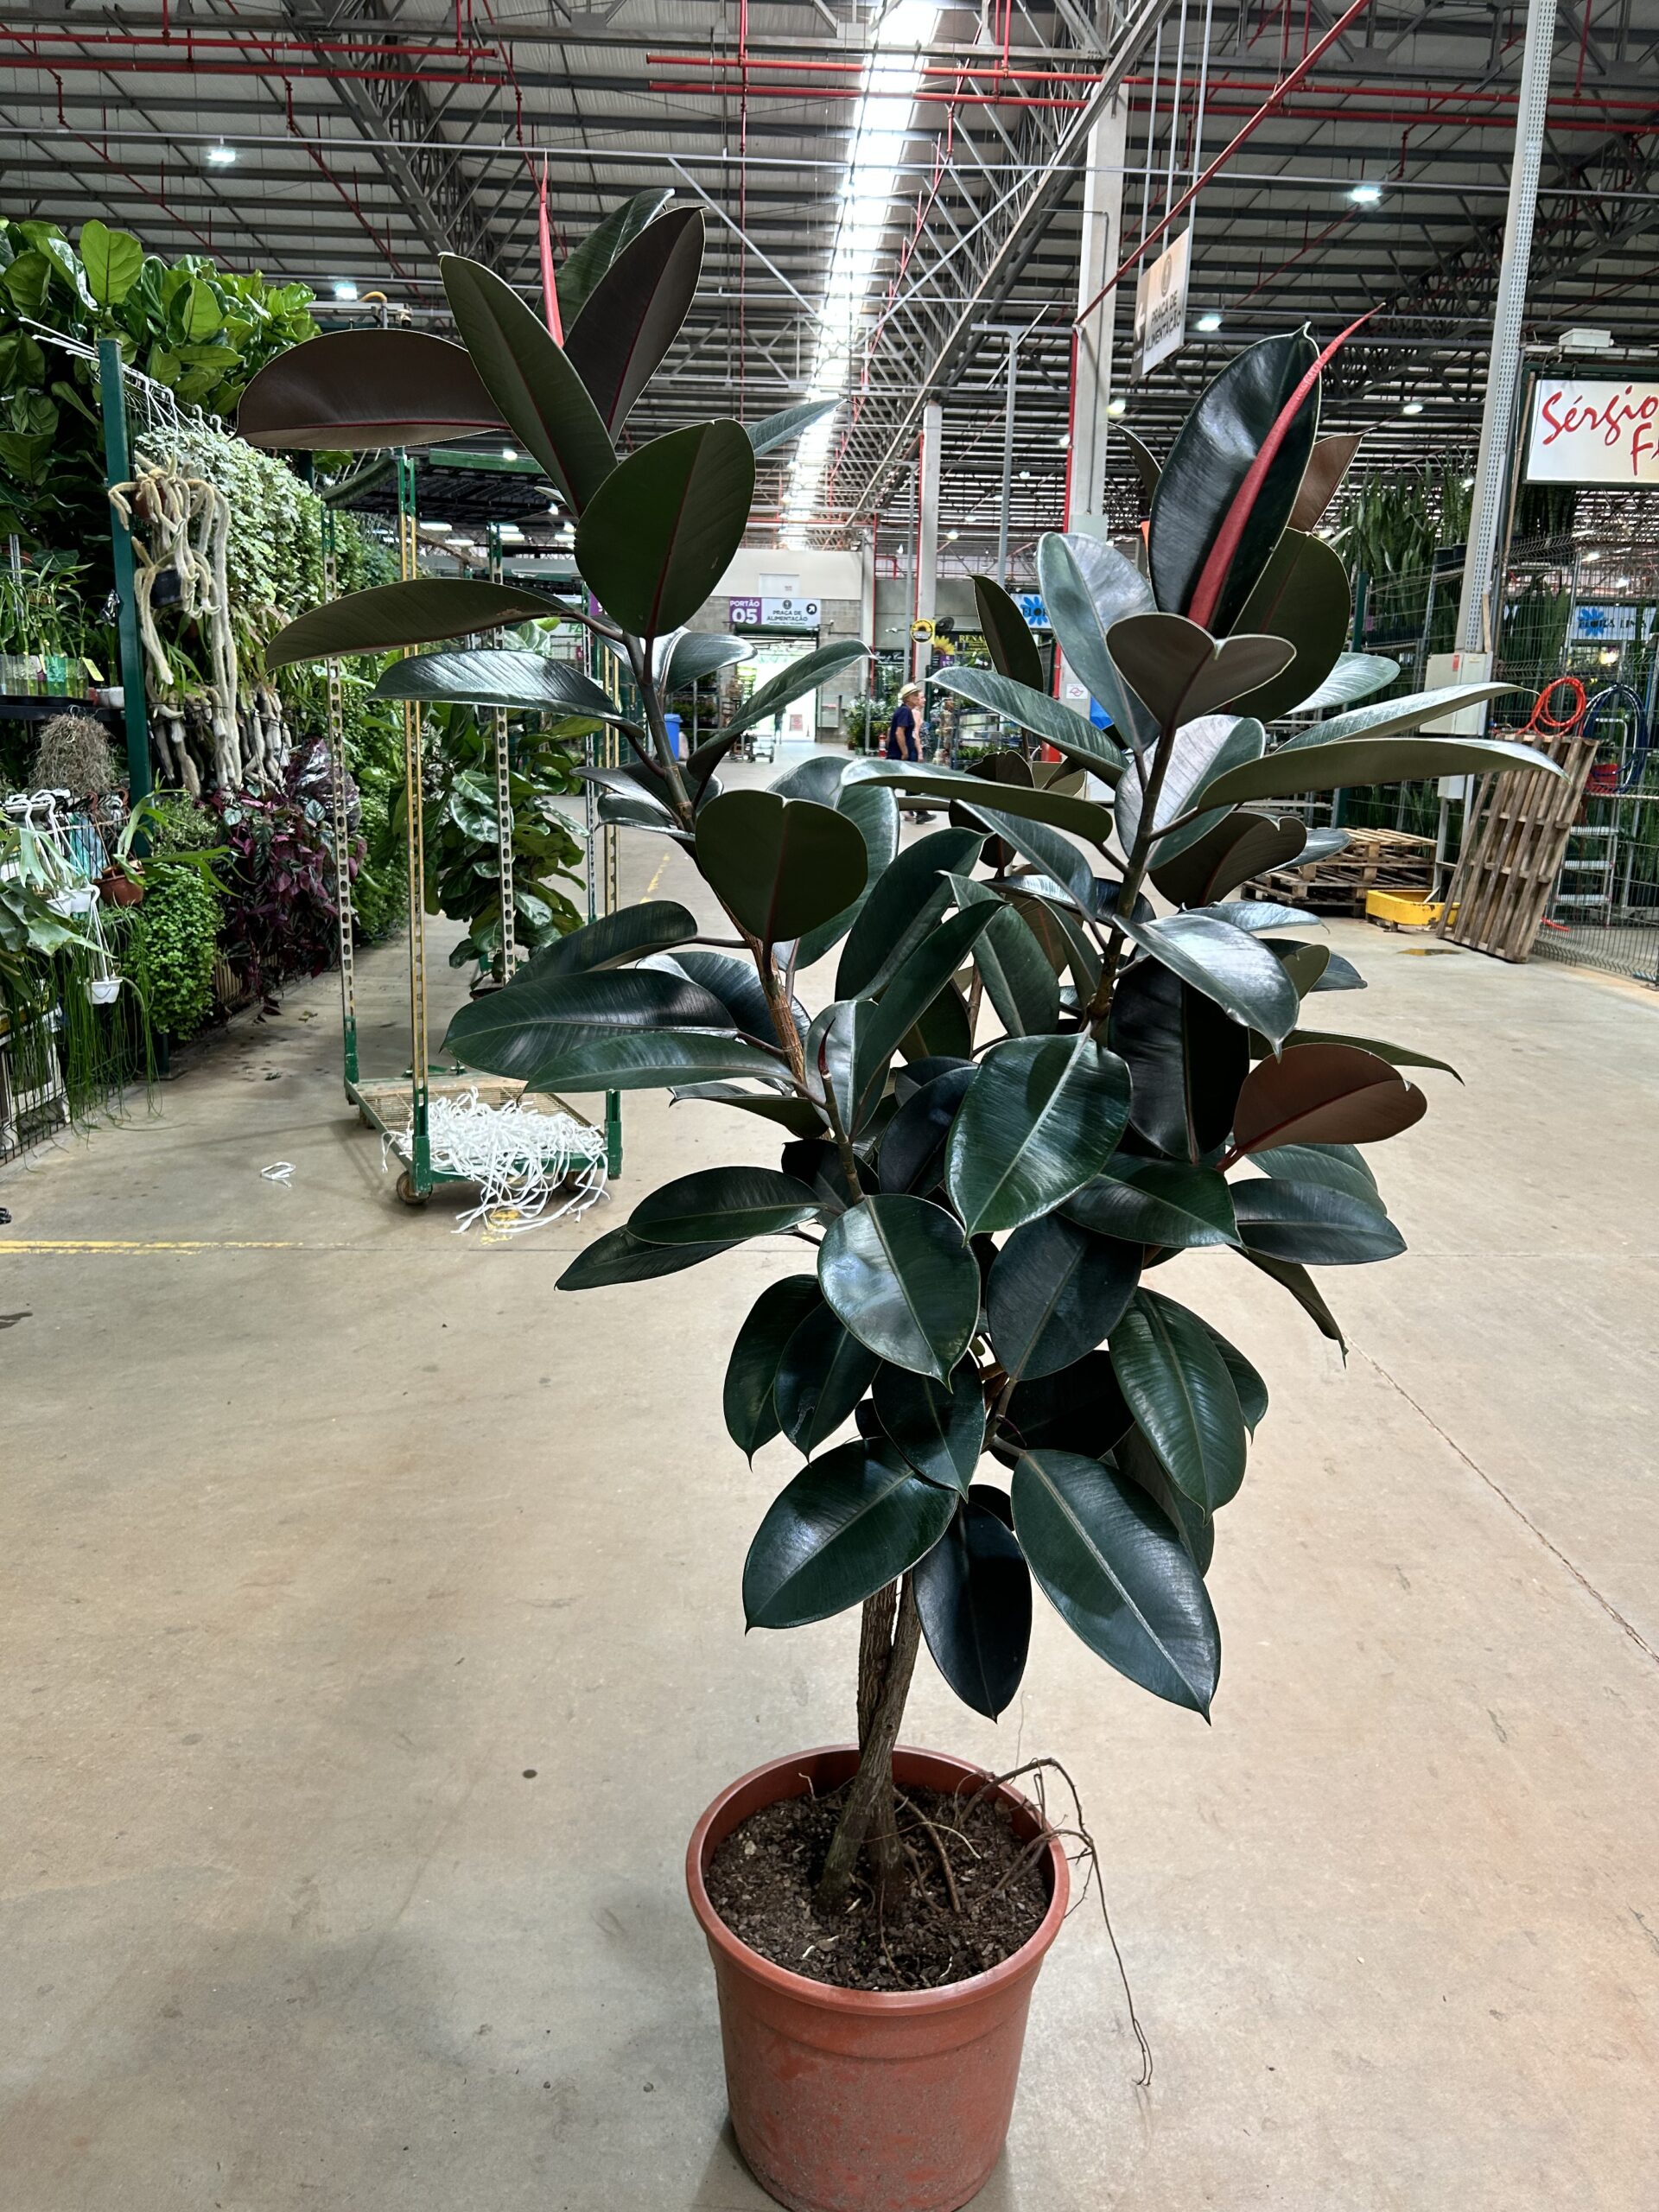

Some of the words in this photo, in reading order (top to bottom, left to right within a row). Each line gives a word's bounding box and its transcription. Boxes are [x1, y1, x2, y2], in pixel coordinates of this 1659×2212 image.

[1169, 289, 1178, 310] DE
[1541, 385, 1659, 446] Sérgio
[729, 599, 760, 607] PORTÃO
[732, 607, 758, 624] 05
